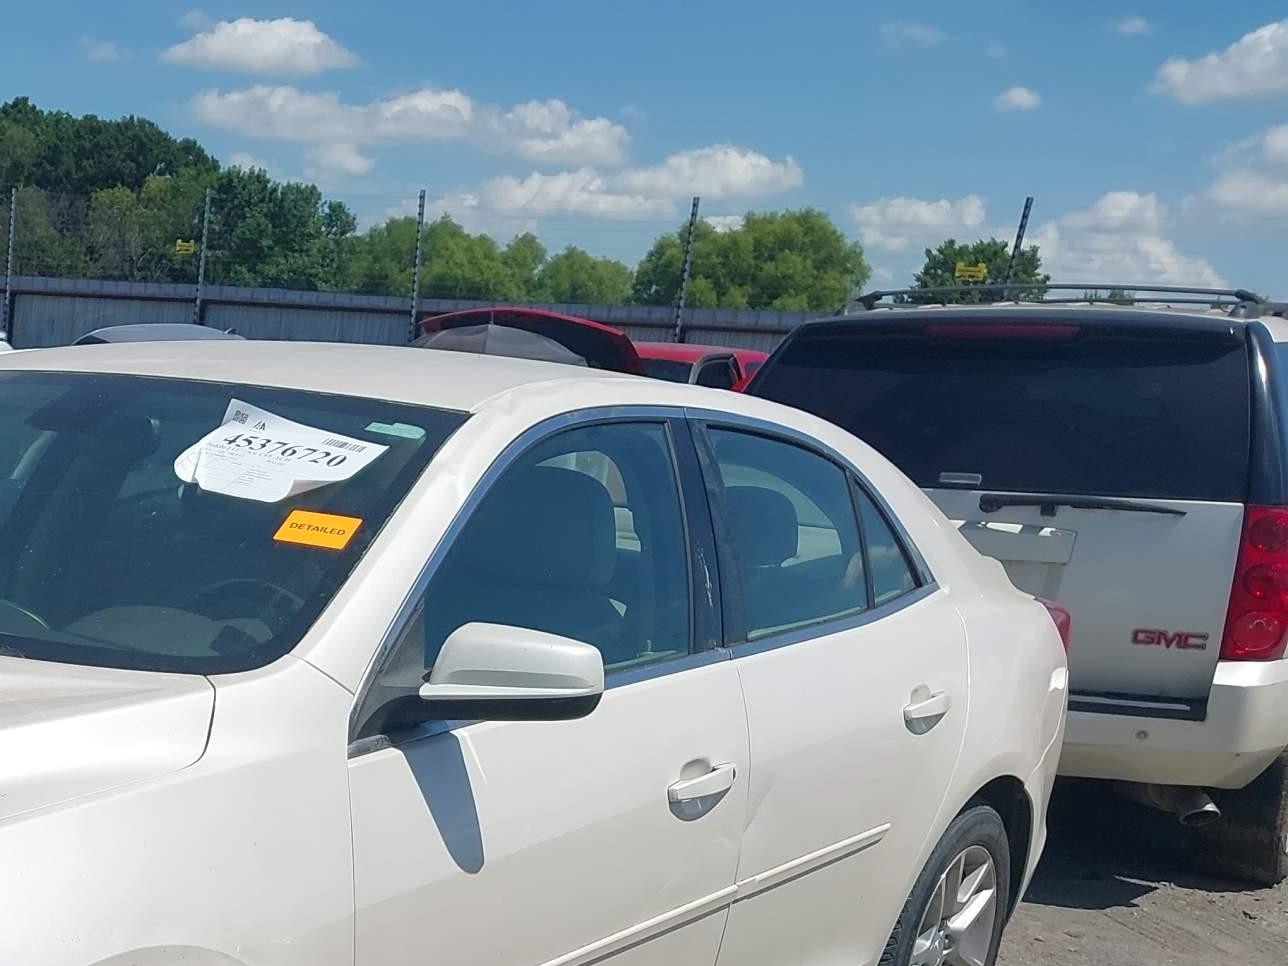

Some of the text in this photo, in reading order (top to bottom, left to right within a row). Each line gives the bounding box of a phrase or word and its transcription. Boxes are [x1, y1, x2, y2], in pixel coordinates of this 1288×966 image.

[223, 433, 348, 468] 45376720
[289, 521, 346, 537] DETAILED
[1131, 629, 1209, 650] GMC
